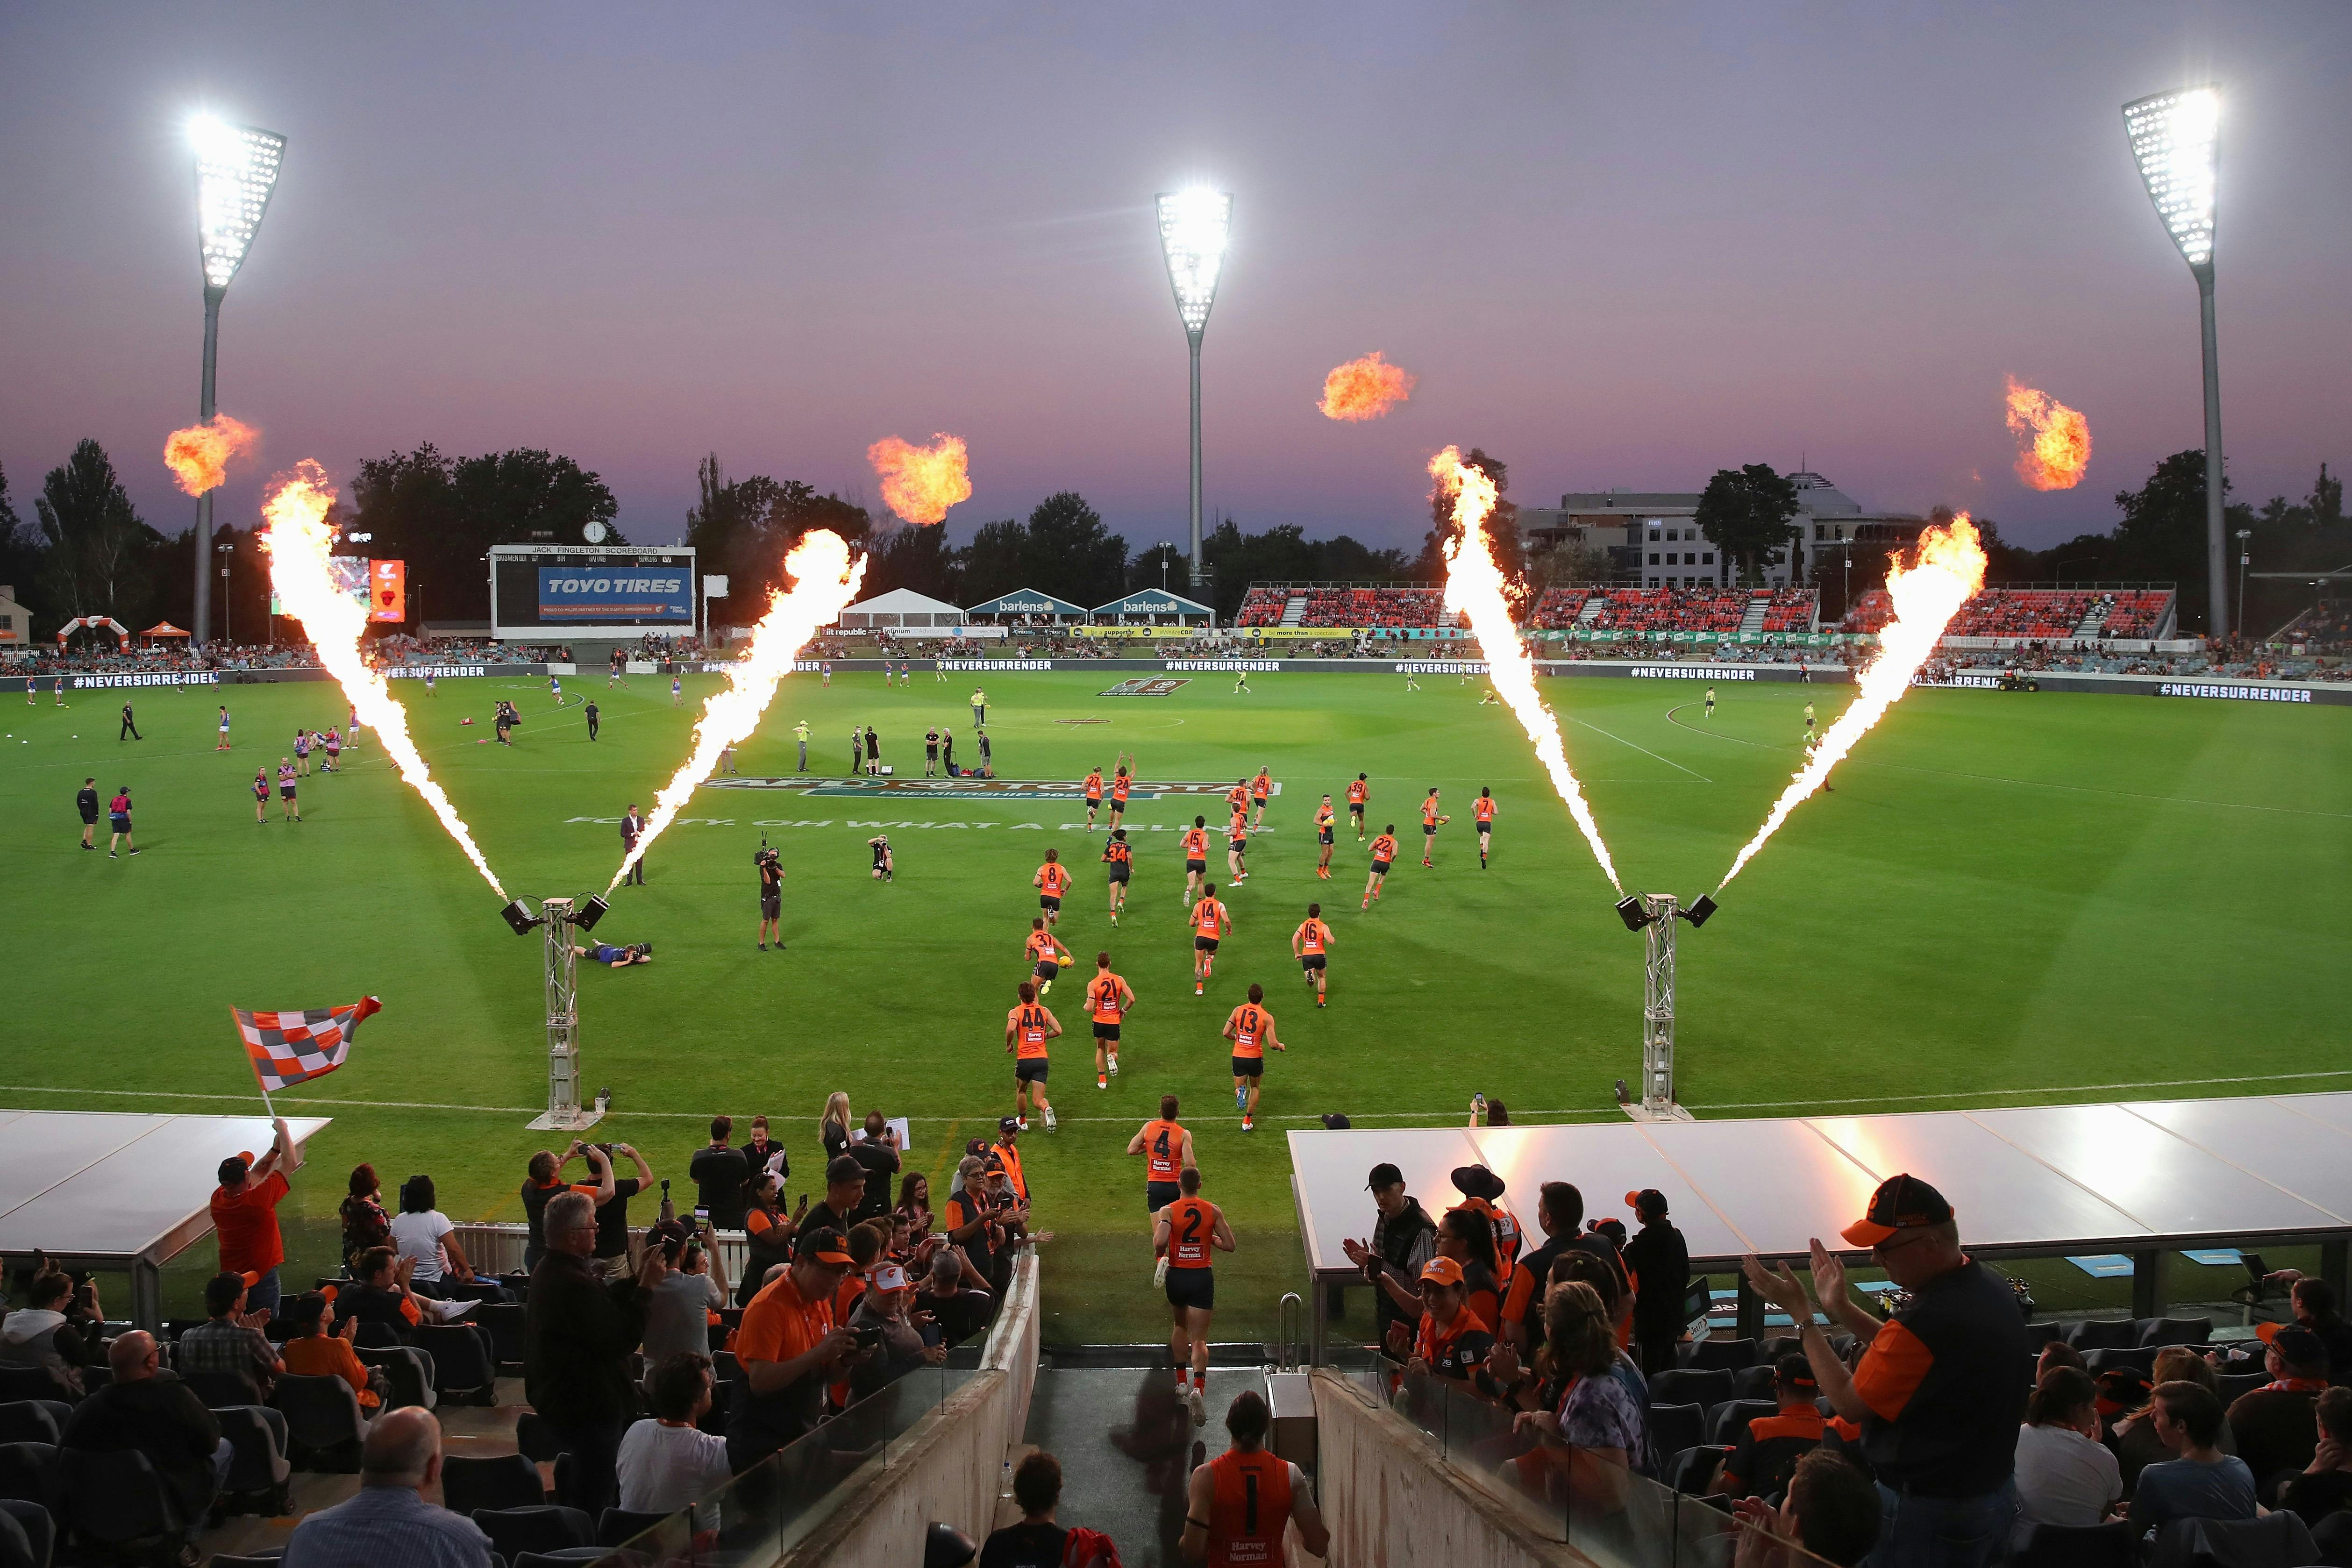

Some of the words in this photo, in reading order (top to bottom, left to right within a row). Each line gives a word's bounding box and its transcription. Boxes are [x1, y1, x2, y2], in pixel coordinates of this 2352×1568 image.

[548, 578, 610, 593] TOYO
[613, 578, 682, 593] TIRES
[999, 600, 1043, 612] barlens
[1123, 600, 1167, 612] barlens
[835, 628, 867, 637] republic
[1165, 661, 1280, 671] #NEVERSURRENDER
[1631, 667, 1755, 681] #NEVERSURRENDER
[2160, 684, 2311, 702] #NEVERSURRENDER
[1089, 776, 1099, 787] 27
[1116, 779, 1129, 789] 24
[1257, 777, 1265, 788] 19
[1351, 782, 1363, 793] 39
[1233, 790, 1244, 801] 30
[1482, 800, 1489, 812] 7
[846, 820, 1001, 829] WHAT
[1190, 832, 1201, 846] 15
[1376, 838, 1391, 852] 22
[1109, 847, 1126, 862] 34
[1048, 867, 1056, 882] 8
[1202, 903, 1215, 920] 14
[1305, 923, 1317, 941] 16
[1036, 933, 1052, 948] 37
[1100, 979, 1117, 1002] 21
[1022, 1008, 1045, 1031] 44
[1239, 1009, 1258, 1033] 13
[1154, 1130, 1170, 1159] 4
[1182, 1207, 1202, 1243] 2
[1246, 1475, 1258, 1536] 1
[1231, 1541, 1267, 1553] Harvey
[1229, 1551, 1268, 1562] Norman
